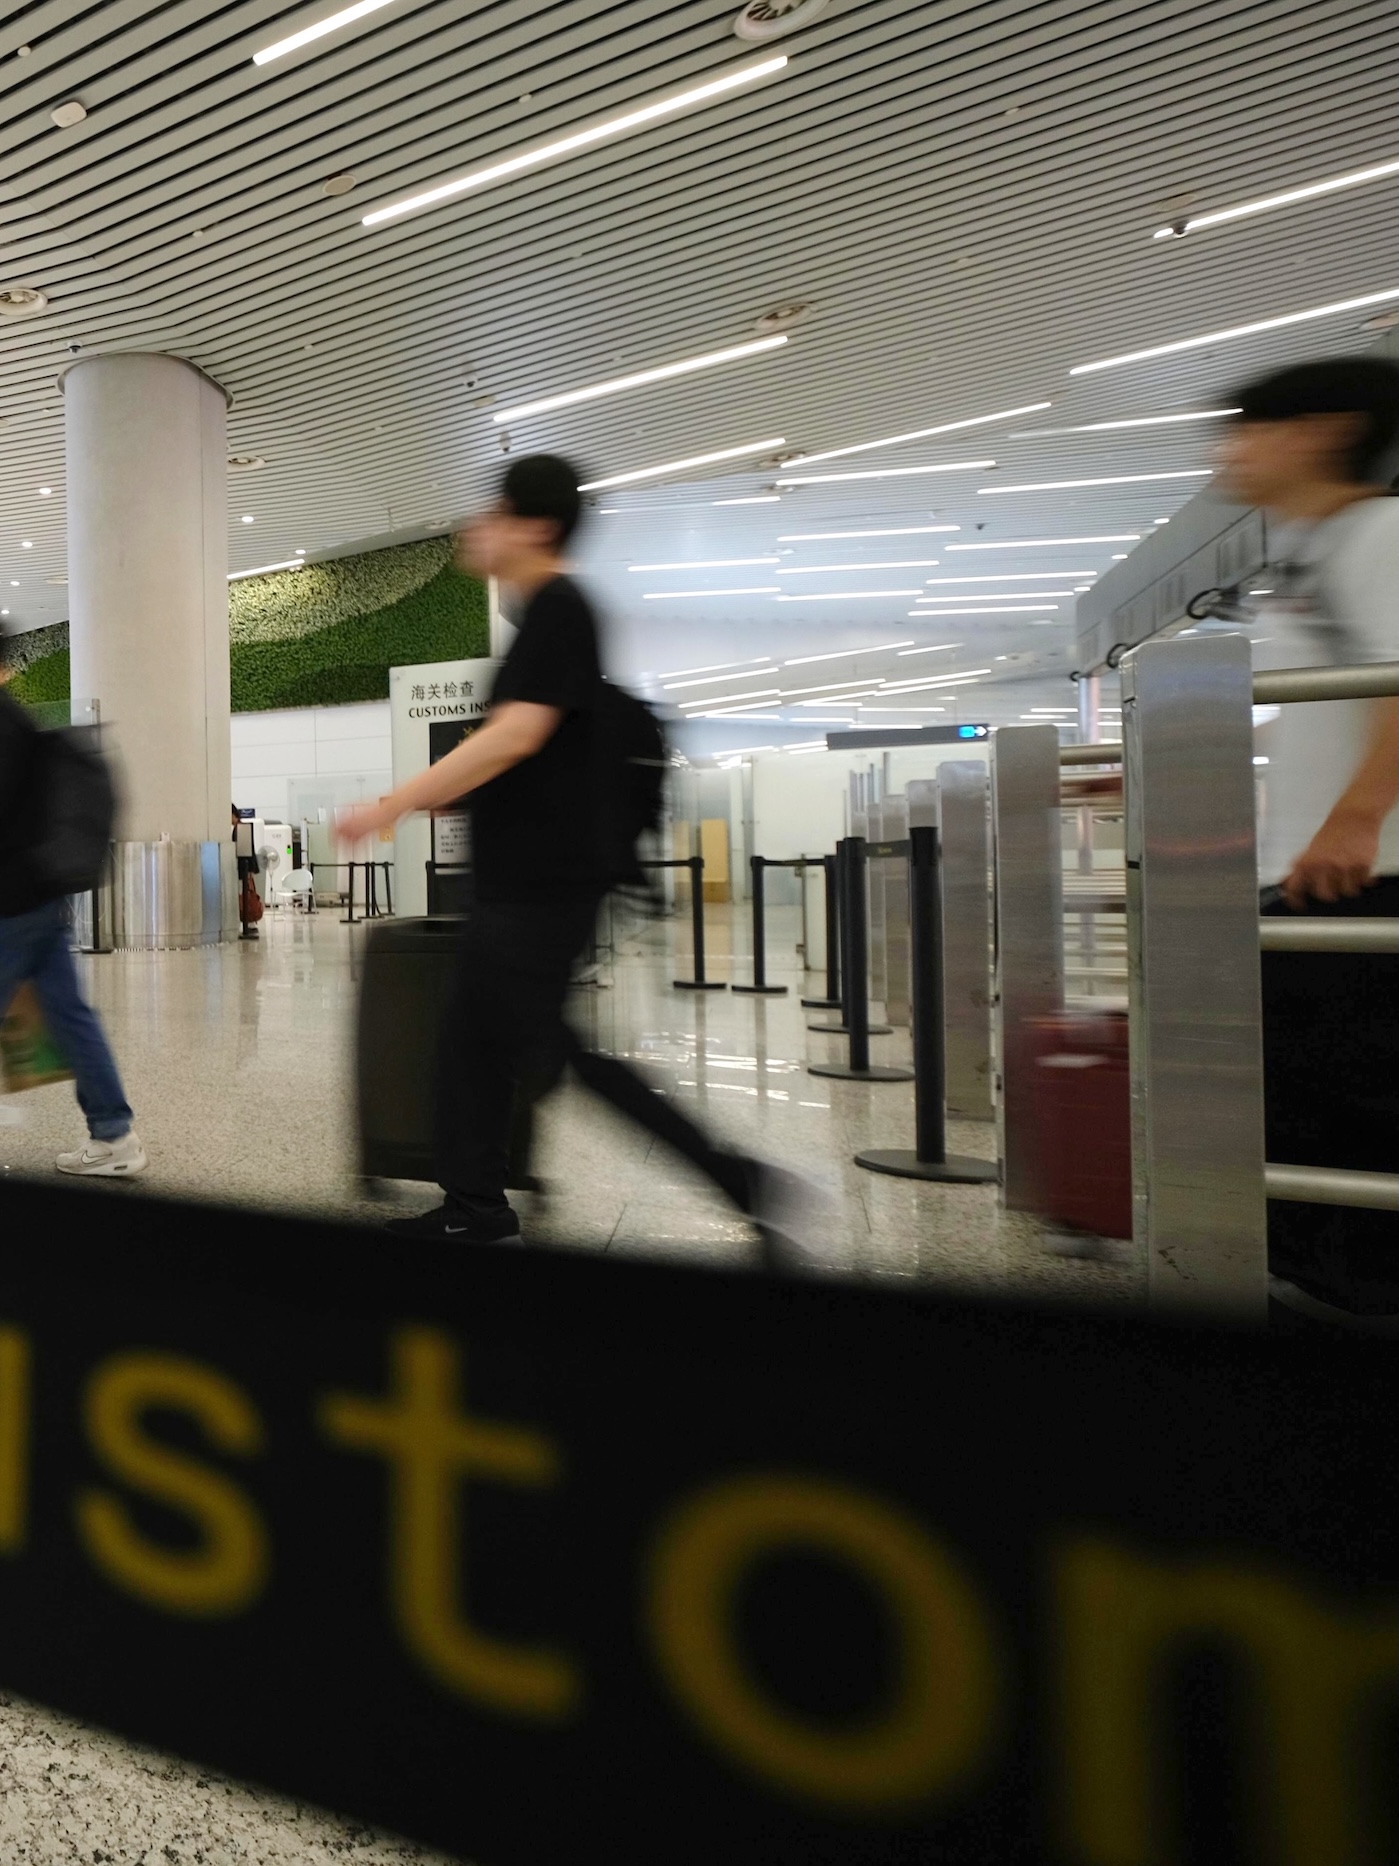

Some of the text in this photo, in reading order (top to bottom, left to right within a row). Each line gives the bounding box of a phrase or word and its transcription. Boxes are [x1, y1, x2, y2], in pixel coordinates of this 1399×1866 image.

[411, 680, 474, 701] 海关检查
[408, 701, 491, 718] CUSTOMS INS
